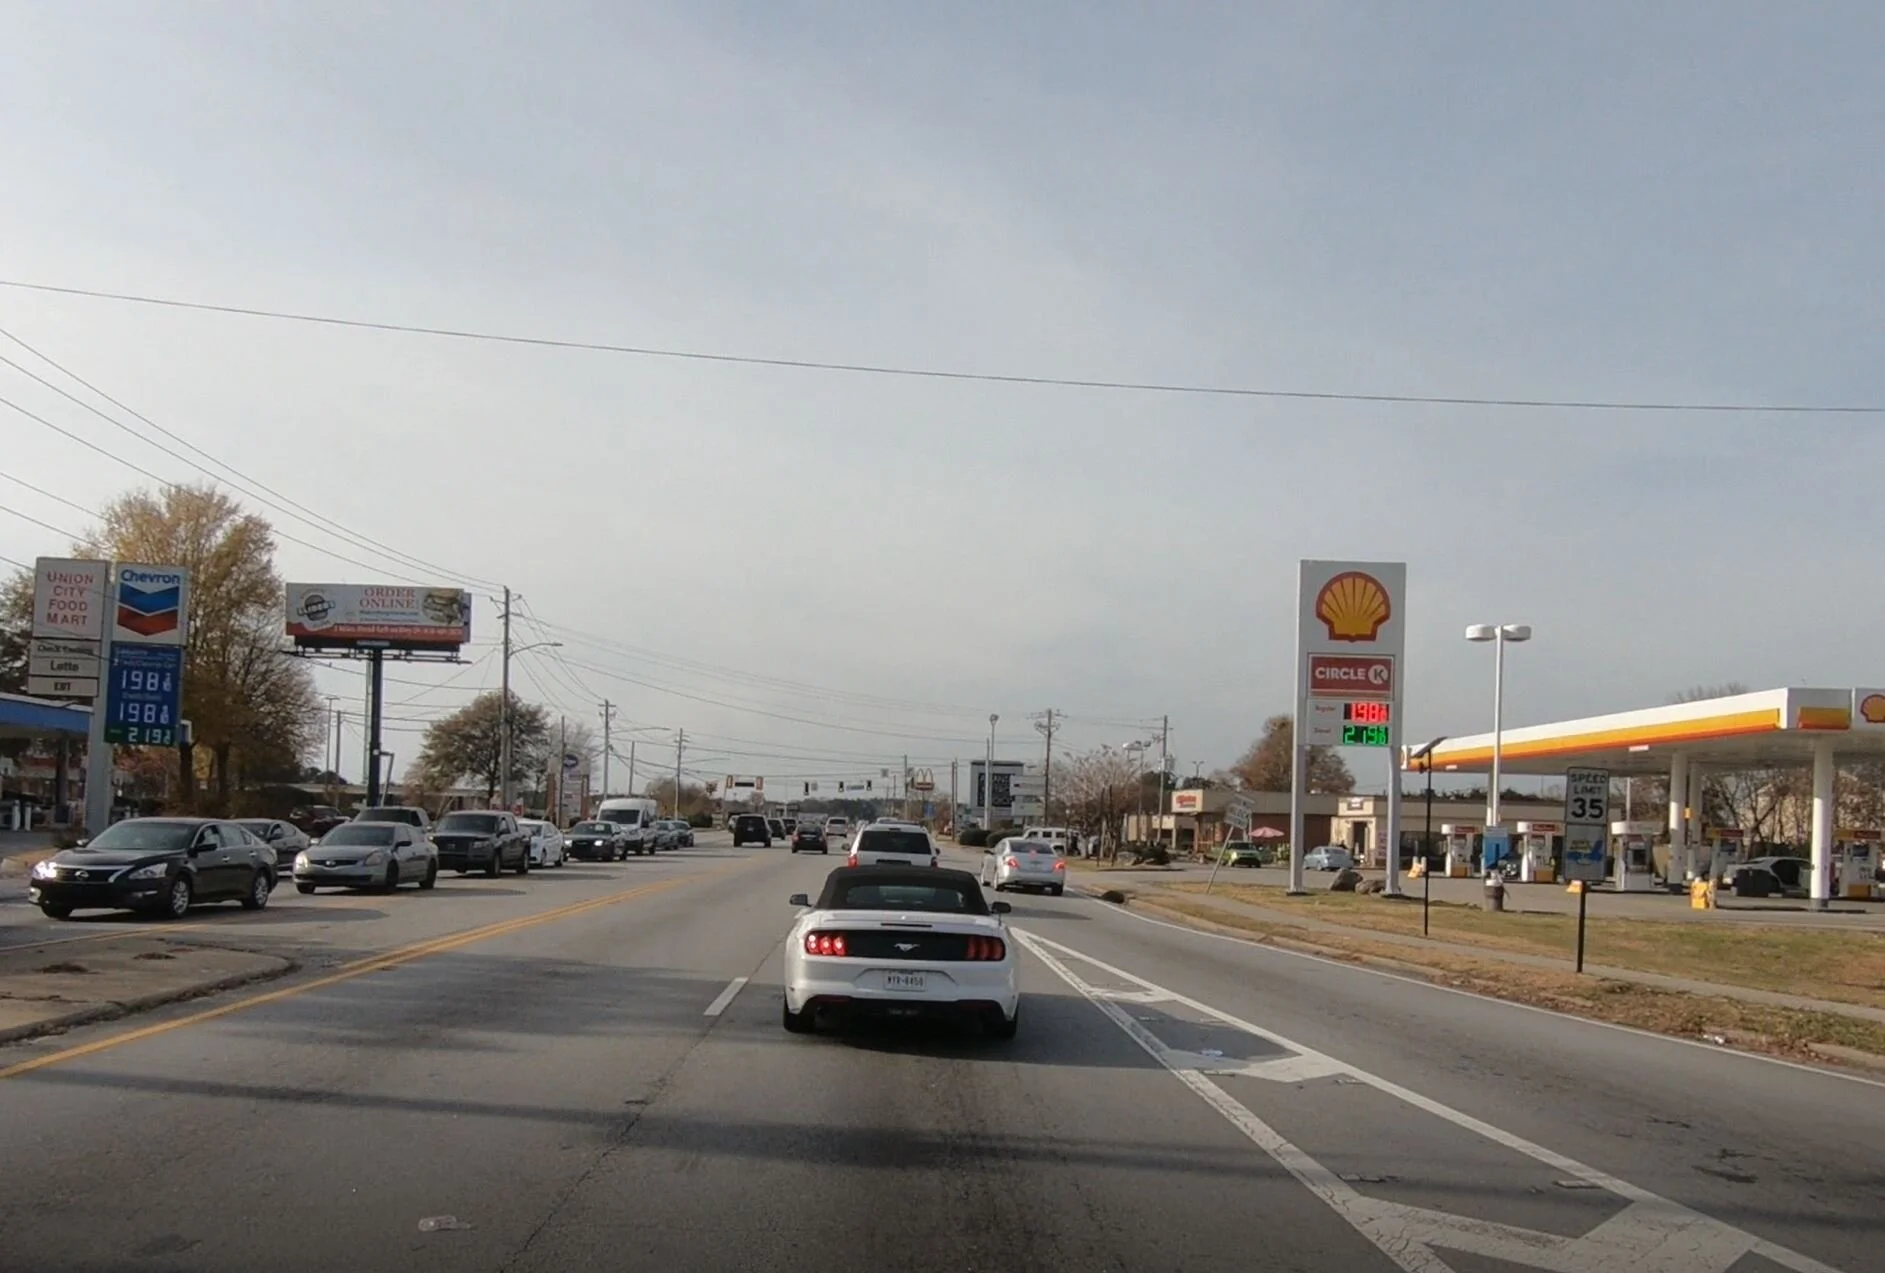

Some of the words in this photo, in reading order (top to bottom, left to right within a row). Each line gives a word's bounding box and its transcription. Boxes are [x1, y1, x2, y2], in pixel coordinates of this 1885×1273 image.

[47, 571, 94, 585] UNION
[120, 569, 181, 584] Chevron
[53, 585, 87, 597] CITY
[363, 587, 416, 598] ORDER
[48, 599, 88, 611] FOOD
[359, 598, 416, 609] ONLINE
[46, 612, 88, 625] MART
[1314, 666, 1367, 680] CIRCLE
[1571, 772, 1606, 784] SPEED
[1573, 784, 1602, 795] LIMIT
[1571, 797, 1604, 818] 35
